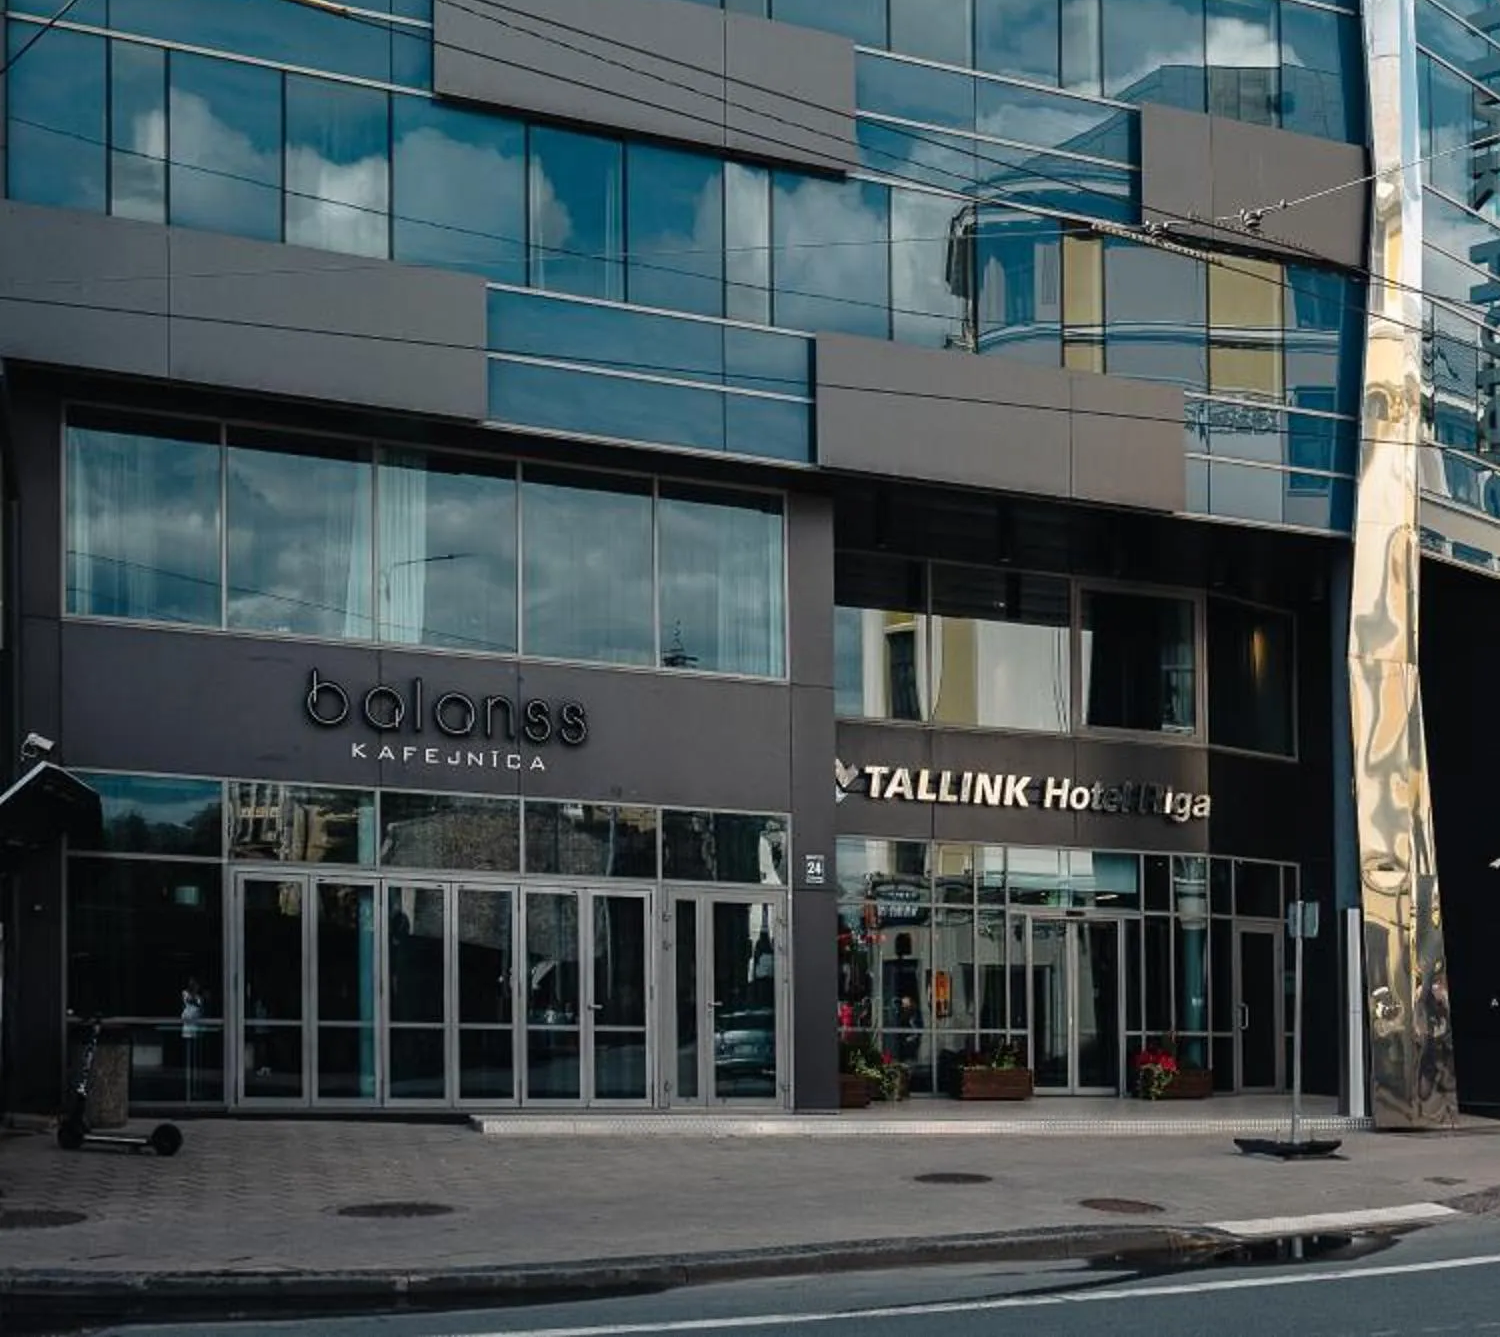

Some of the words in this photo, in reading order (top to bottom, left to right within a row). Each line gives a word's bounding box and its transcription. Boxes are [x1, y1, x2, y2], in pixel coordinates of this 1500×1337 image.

[306, 666, 590, 745] balanss
[351, 742, 546, 772] KAFEJNĪCA
[863, 765, 1032, 809] TALLINK
[1043, 775, 1132, 814] Hotel
[807, 861, 822, 876] 24
